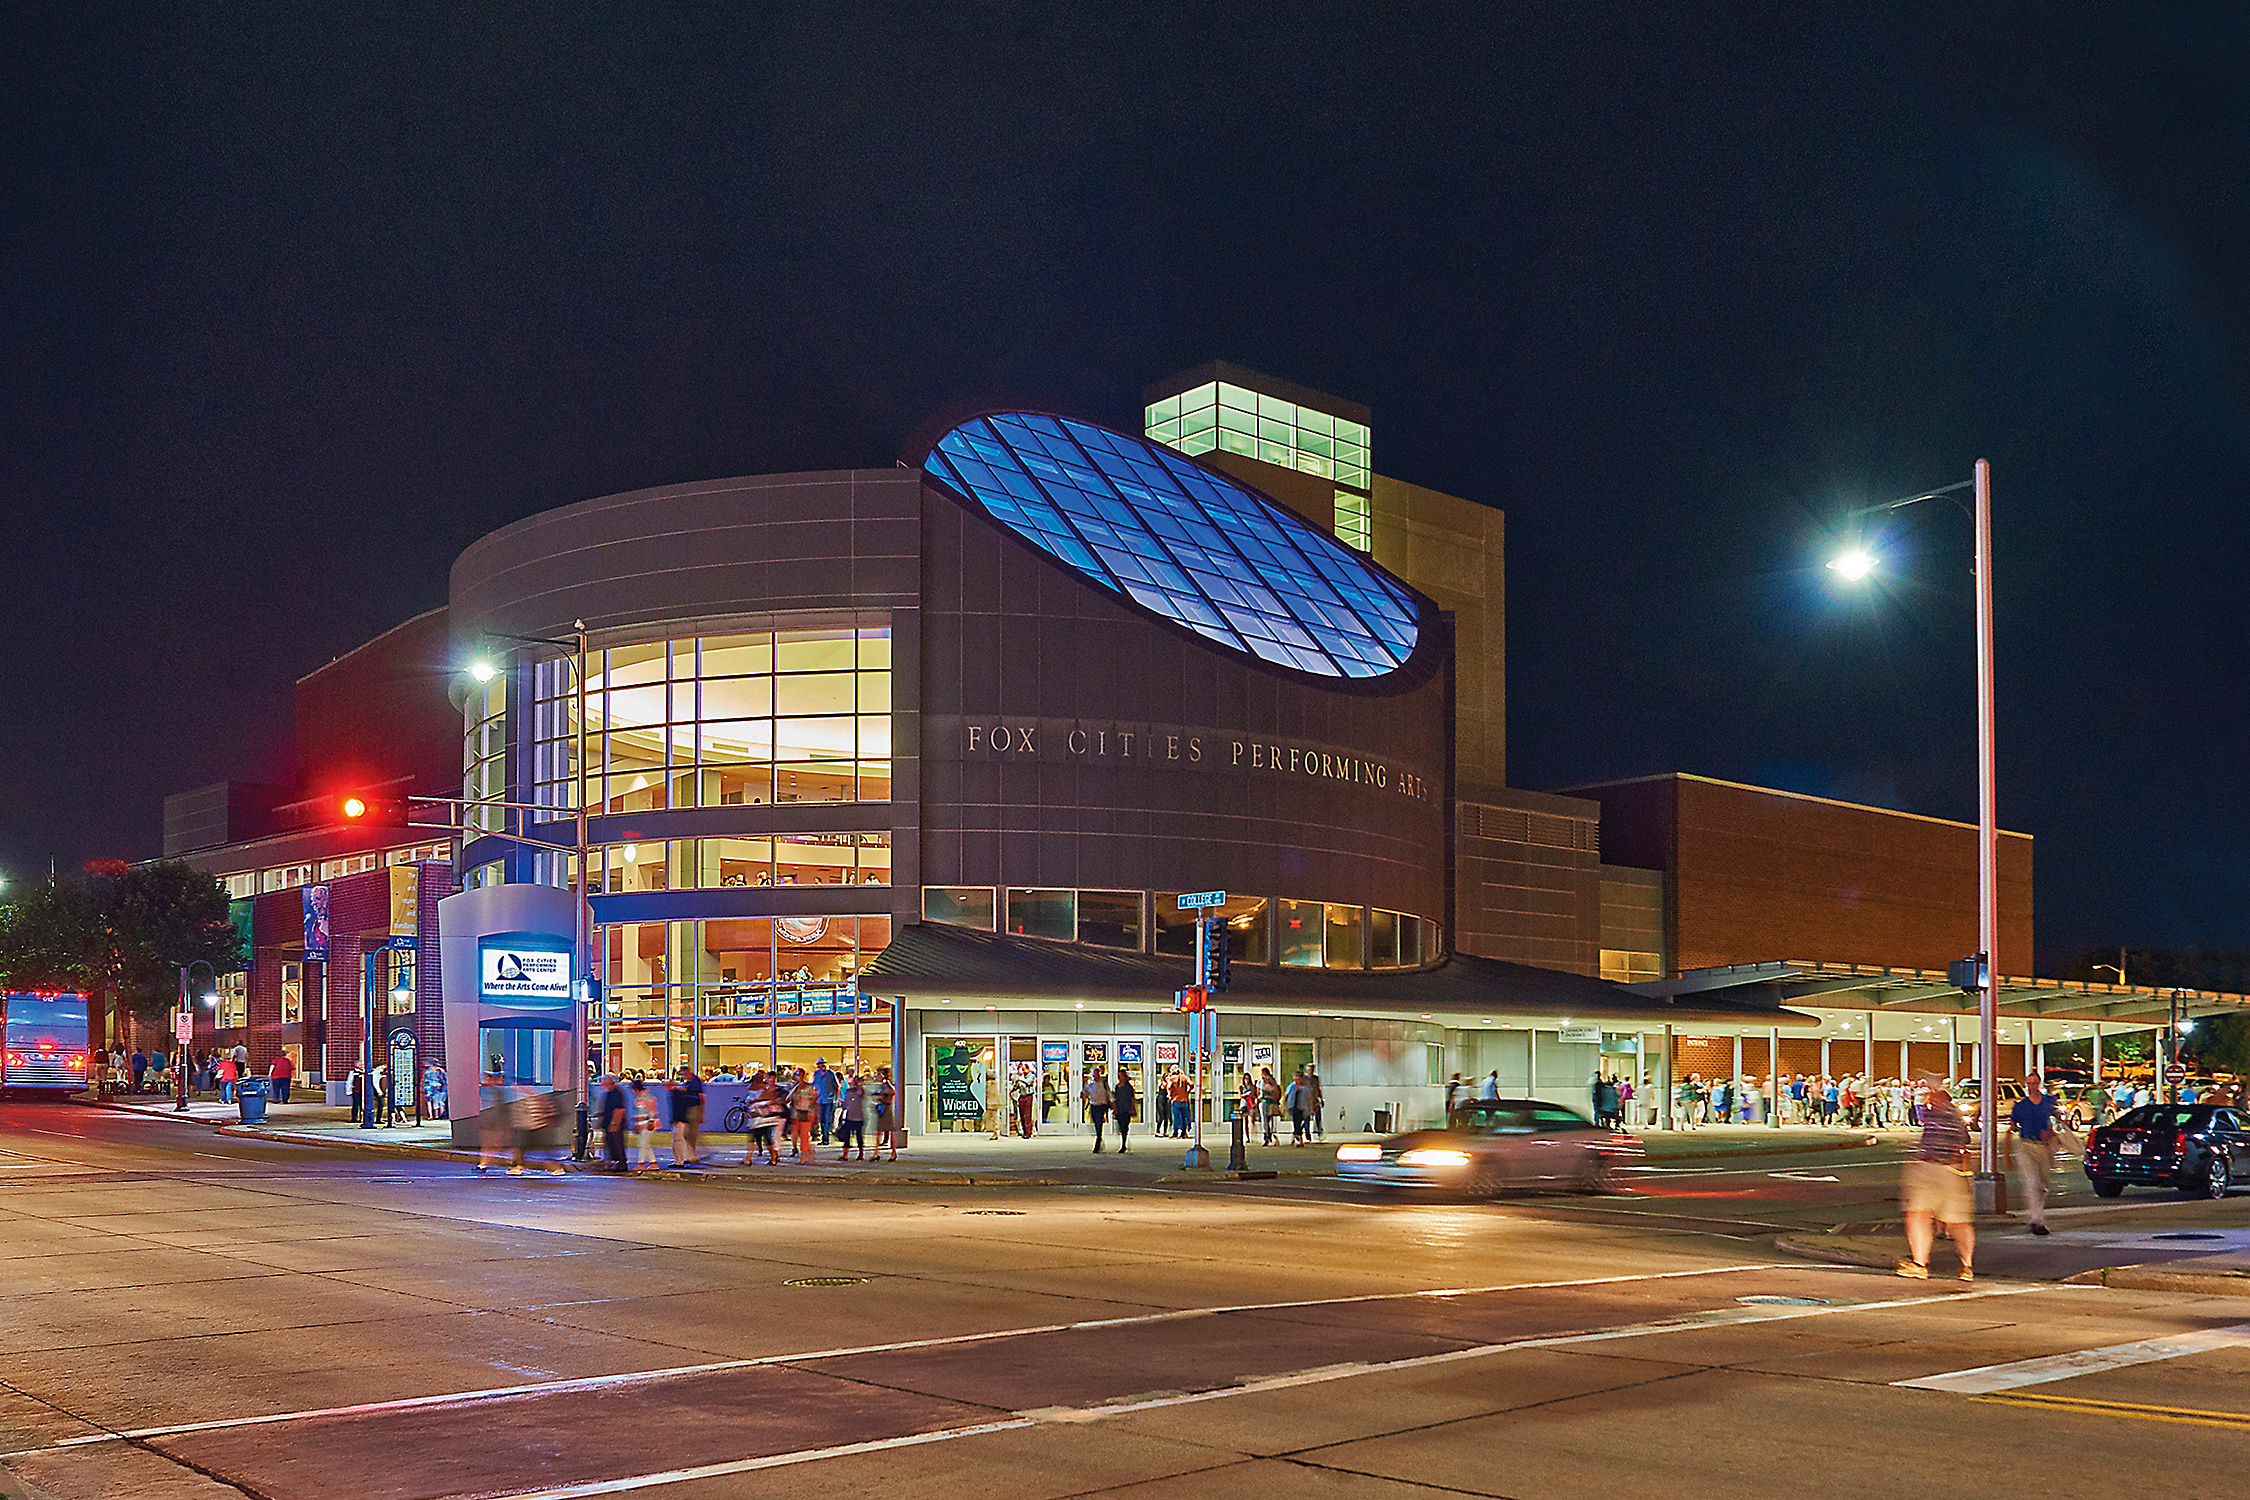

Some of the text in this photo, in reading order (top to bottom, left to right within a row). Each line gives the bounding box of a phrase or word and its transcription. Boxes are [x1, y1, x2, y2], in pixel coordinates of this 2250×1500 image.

[968, 726, 1034, 752] FOX
[1068, 730, 1201, 762] CITIES
[1232, 741, 1387, 788] PERFORMING
[1188, 893, 1213, 906] COLLEGE
[484, 982, 568, 992] Where the Arts Come Alive!
